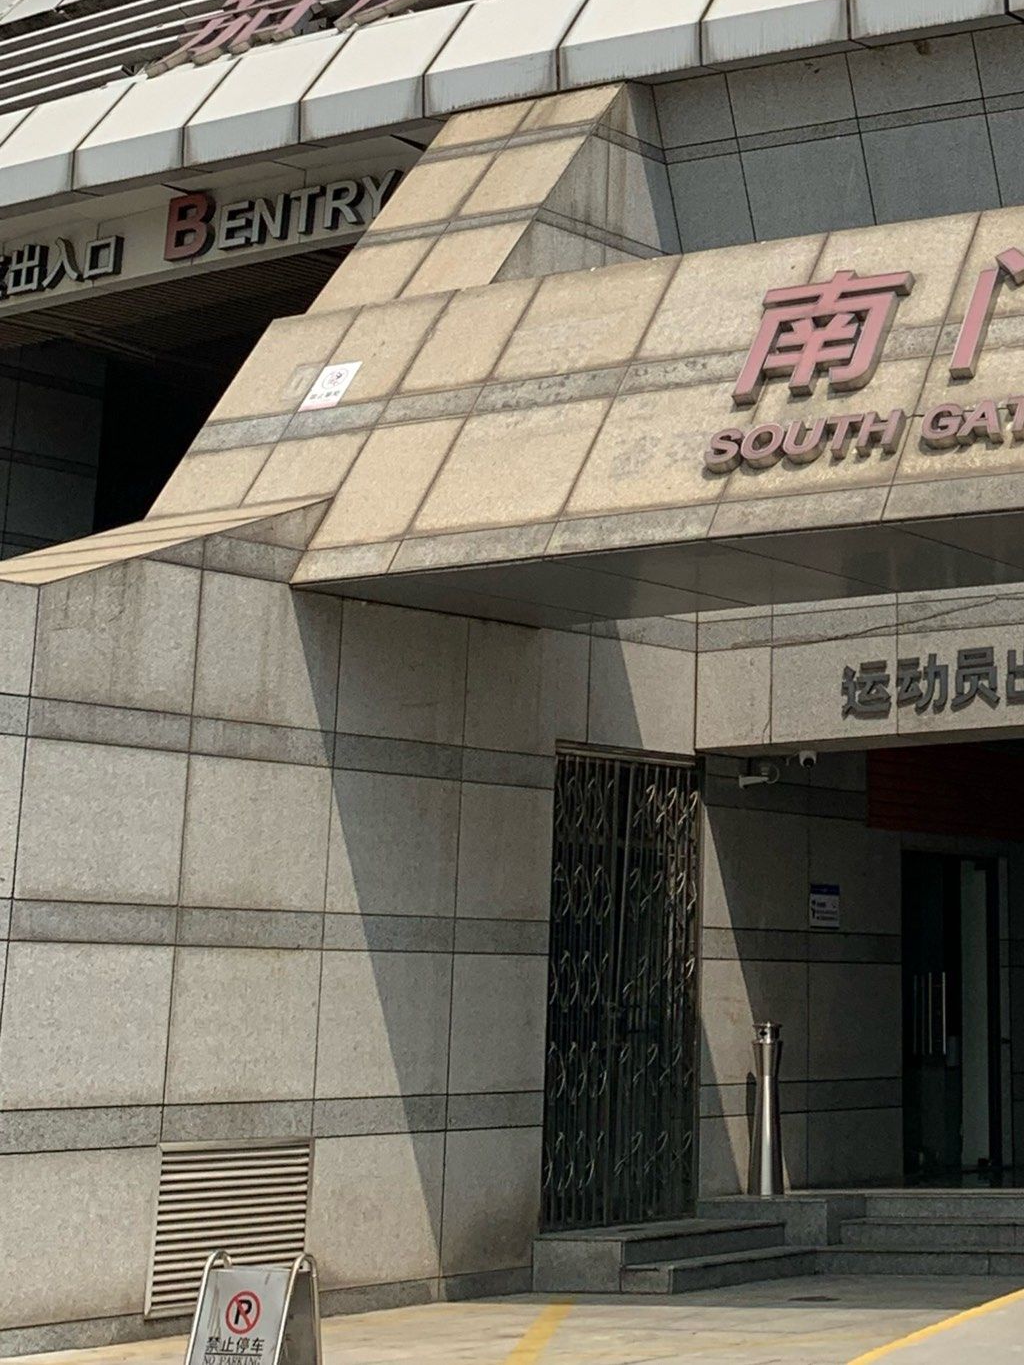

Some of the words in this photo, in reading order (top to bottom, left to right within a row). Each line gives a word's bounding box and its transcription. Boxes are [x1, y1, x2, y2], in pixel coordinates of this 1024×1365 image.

[0, 235, 124, 298] 出入口
[704, 409, 907, 473] SOUTH
[205, 1337, 265, 1354] 禁止停车
